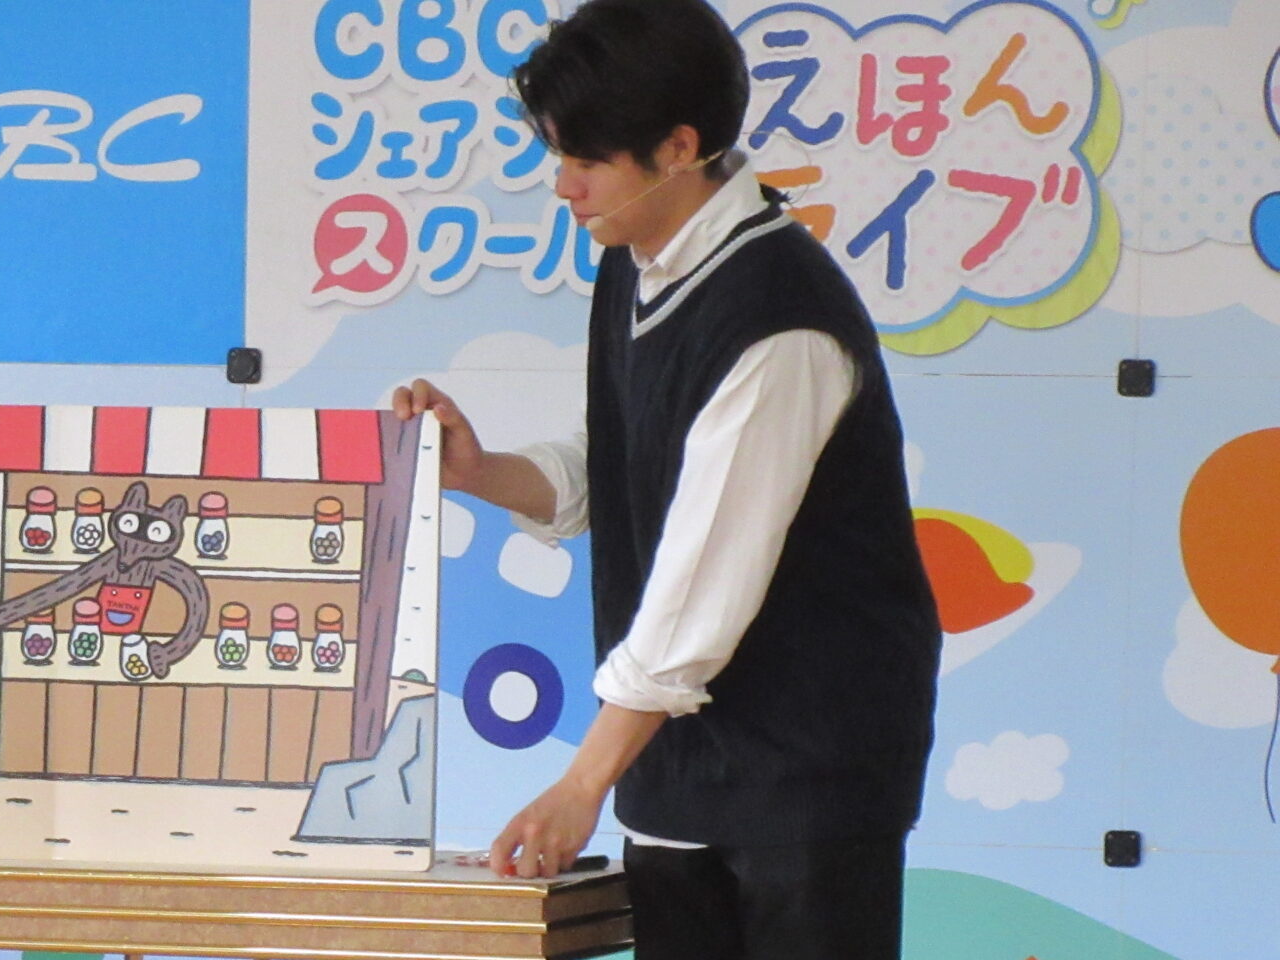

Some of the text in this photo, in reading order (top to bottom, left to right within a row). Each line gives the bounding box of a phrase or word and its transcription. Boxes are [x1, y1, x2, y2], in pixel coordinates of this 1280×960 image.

[313, 0, 548, 81] CBC
[311, 91, 562, 181] シェアシ
[749, 30, 1070, 157] えほん
[328, 204, 600, 284] スクール
